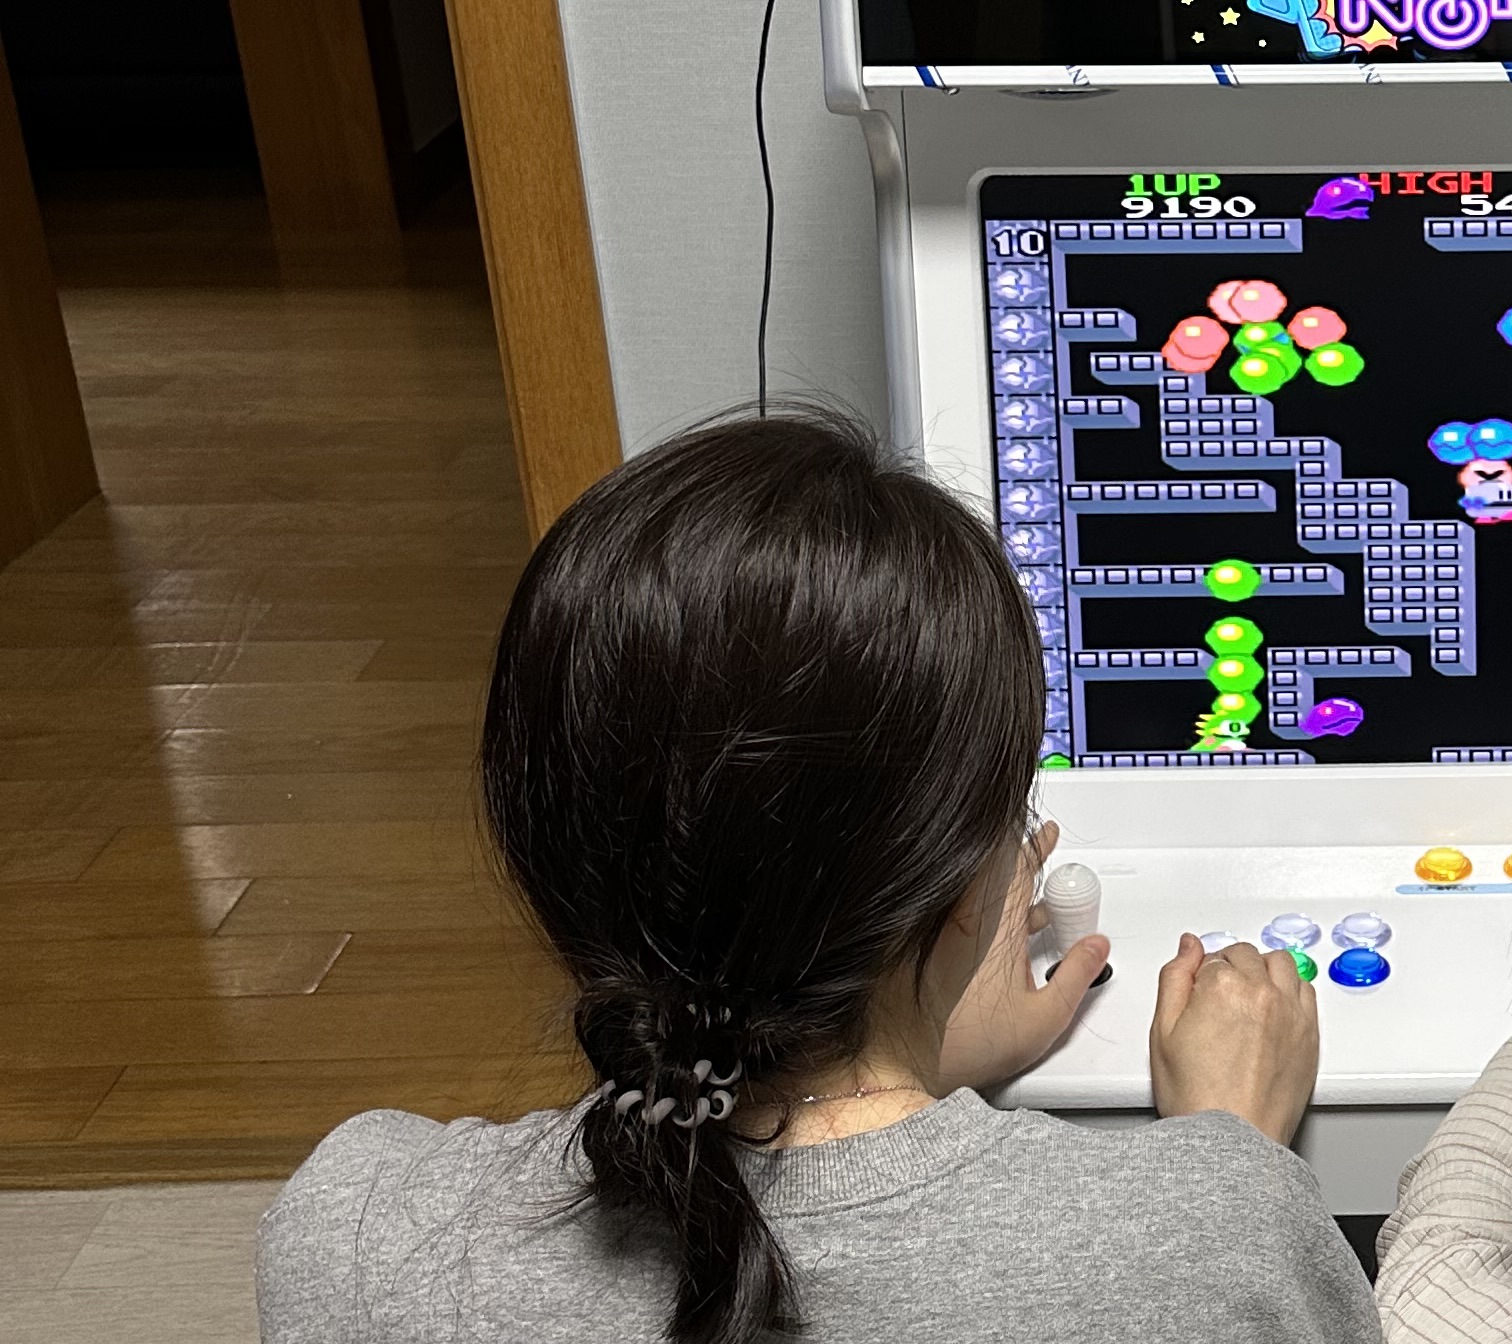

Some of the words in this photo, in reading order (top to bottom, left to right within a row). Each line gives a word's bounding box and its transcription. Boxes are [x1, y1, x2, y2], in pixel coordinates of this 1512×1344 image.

[1125, 173, 1221, 196] 1UP
[1359, 171, 1493, 195] HIGH
[1121, 196, 1256, 219] 9190
[994, 229, 1045, 256] 10
